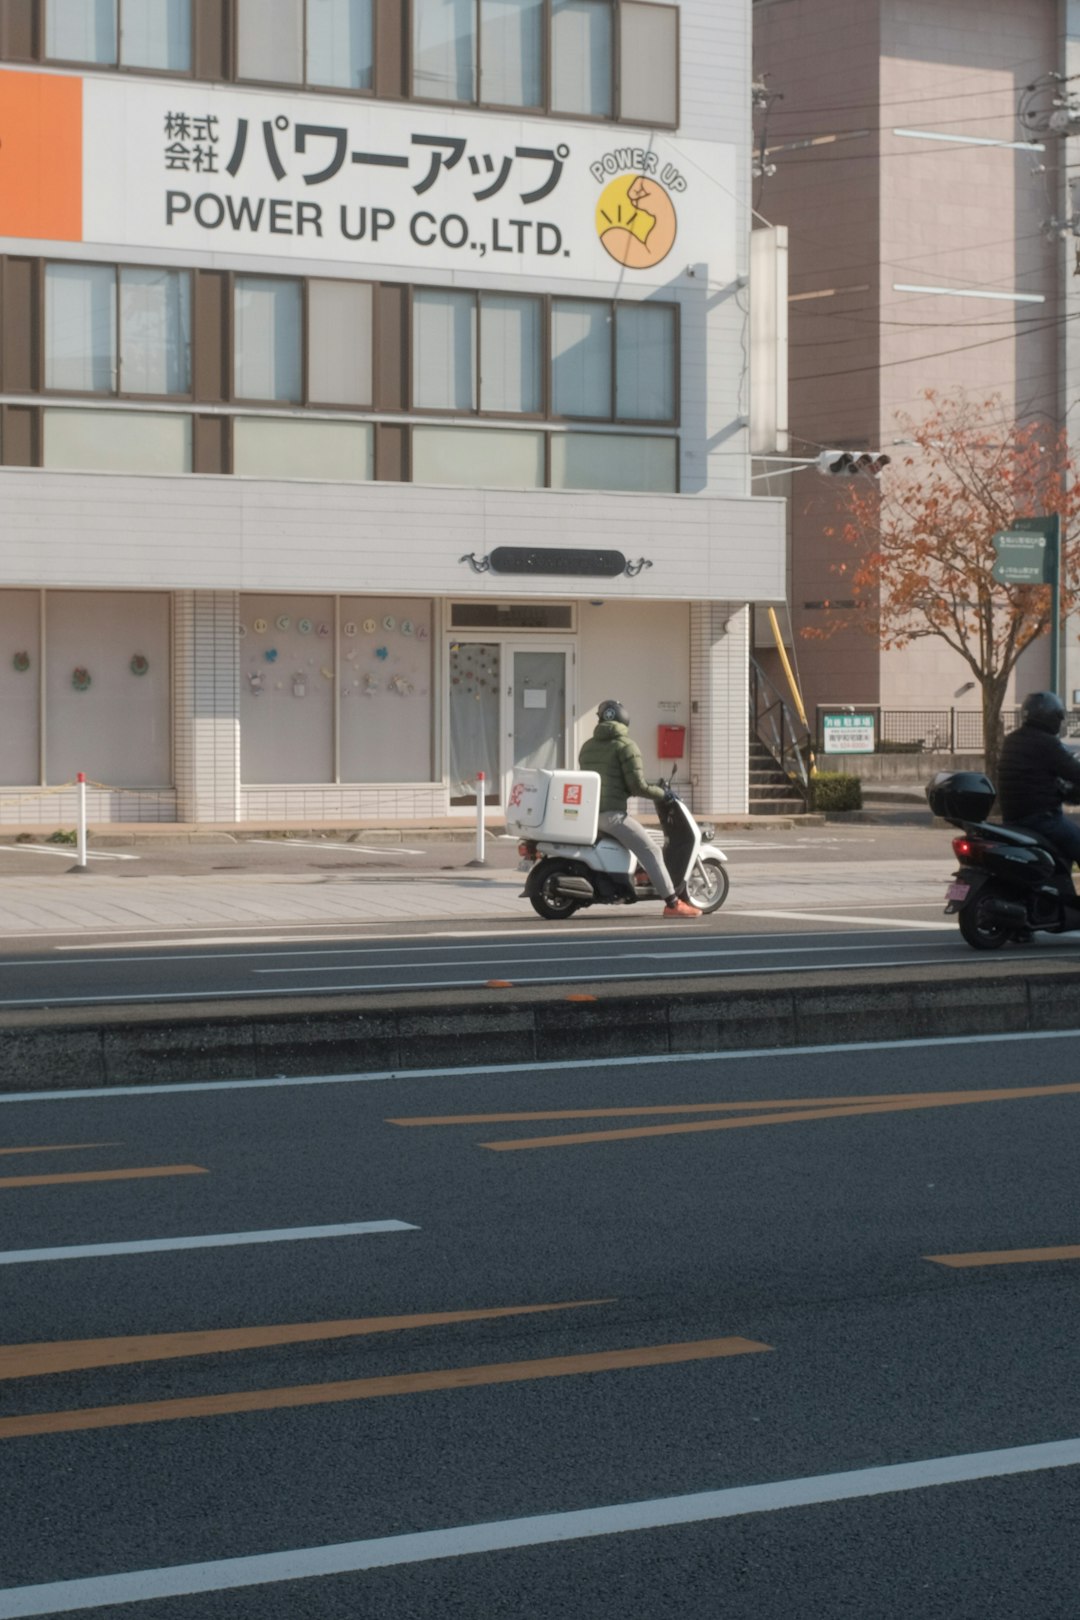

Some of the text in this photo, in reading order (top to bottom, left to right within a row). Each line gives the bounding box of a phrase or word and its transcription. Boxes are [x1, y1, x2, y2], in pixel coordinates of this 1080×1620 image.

[164, 111, 219, 143] 株式
[164, 142, 219, 173] 会社
[225, 115, 570, 205] パワーアップ
[590, 147, 687, 193] POWER UP
[165, 189, 323, 238] POWER
[340, 205, 395, 241] UP
